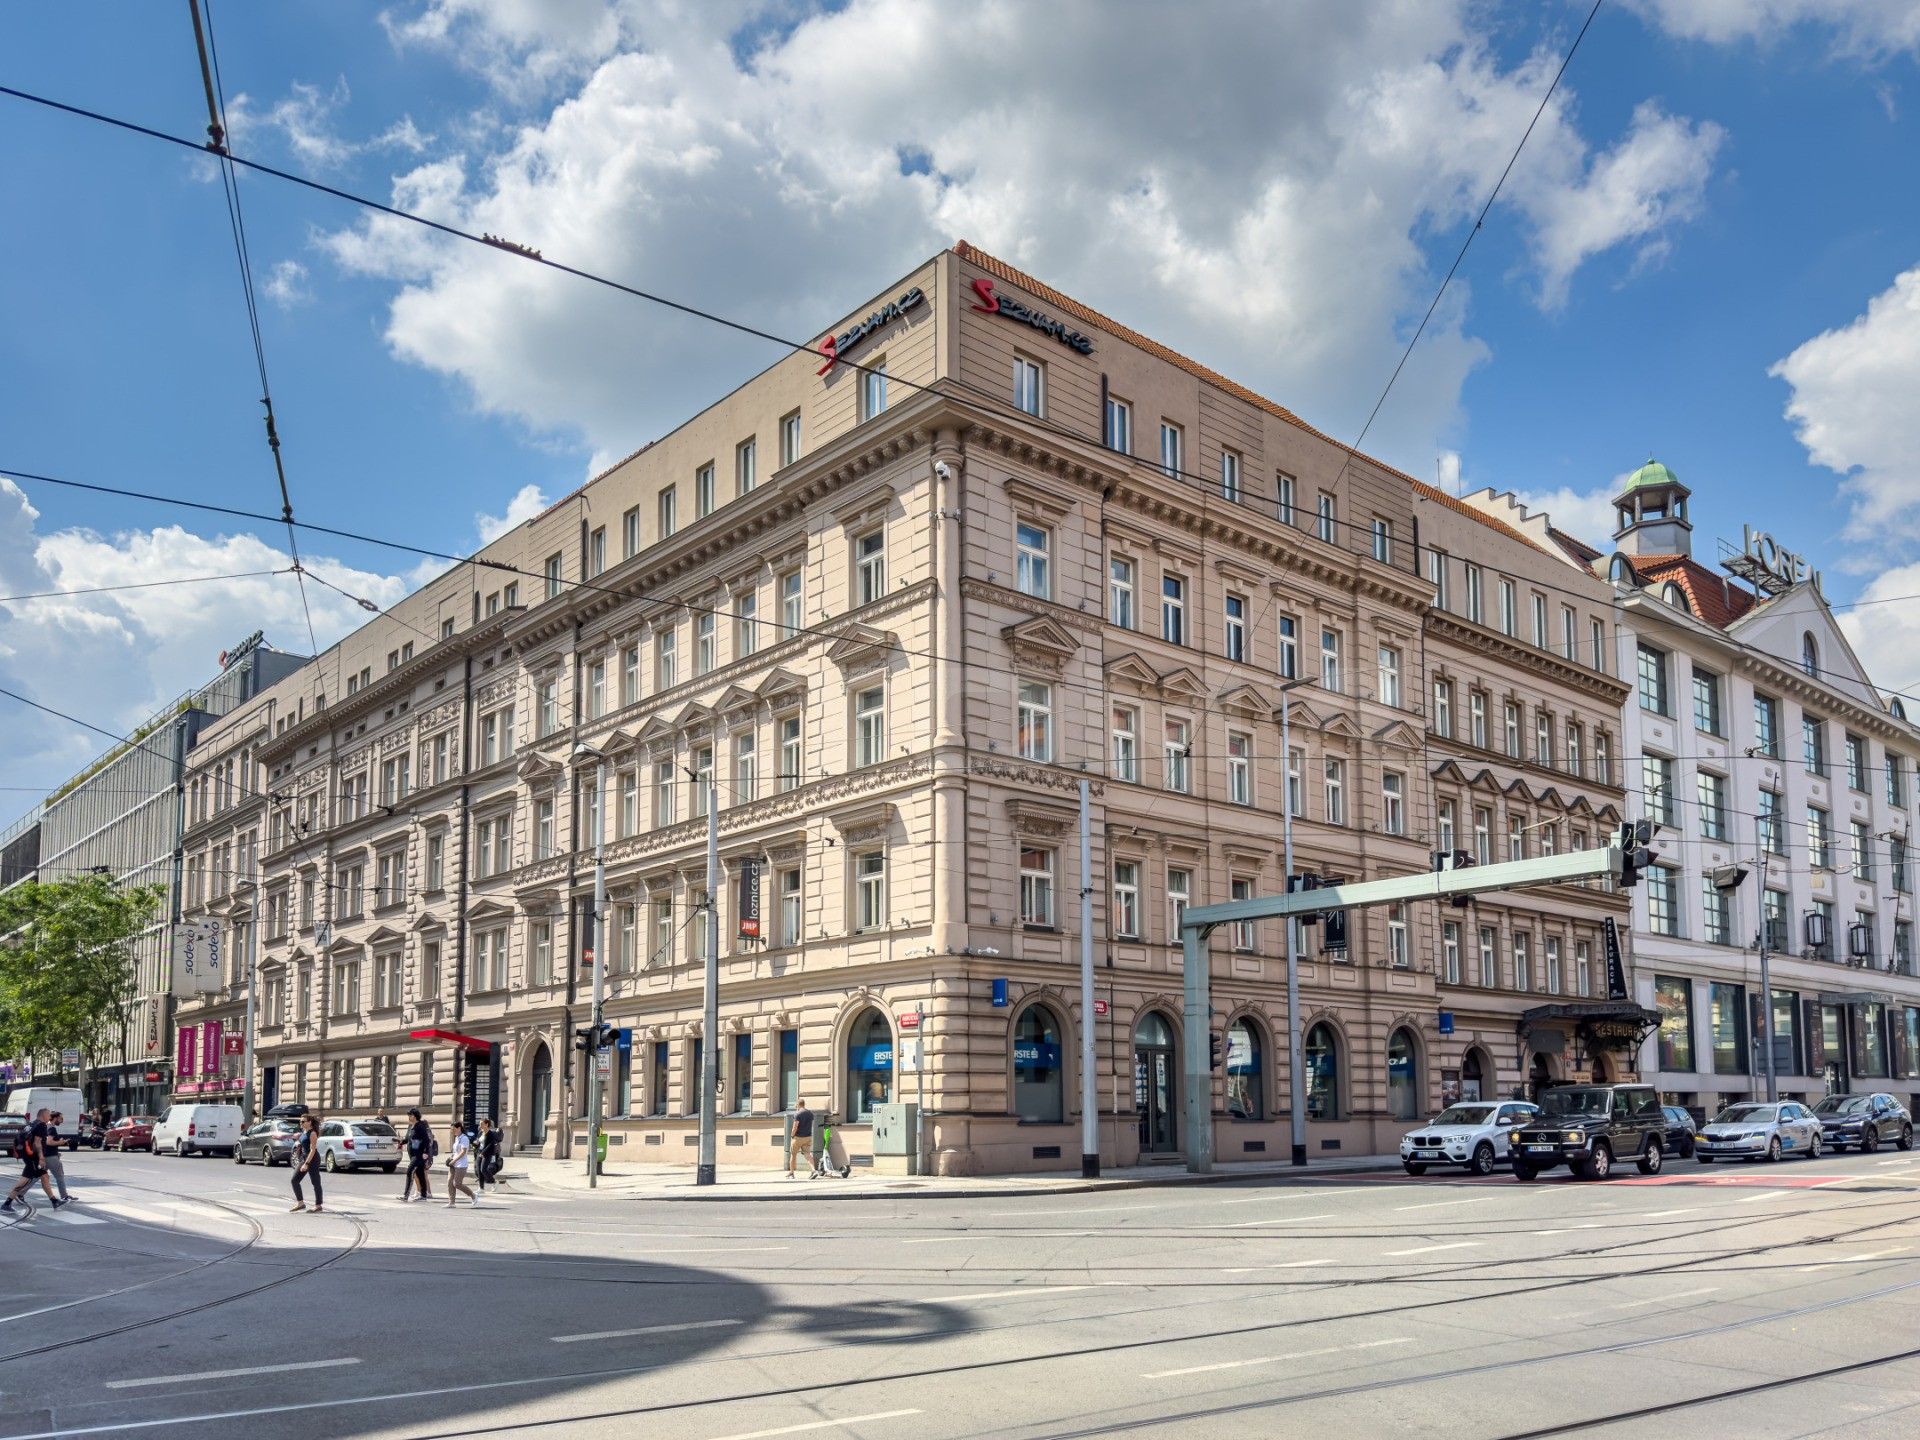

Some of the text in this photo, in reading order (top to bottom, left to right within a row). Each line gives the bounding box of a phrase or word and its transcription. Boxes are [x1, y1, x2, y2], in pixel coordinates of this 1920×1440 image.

[816, 286, 923, 376] SEZNAM.CZ
[970, 278, 1094, 355] SEZNAM.CZ
[208, 921, 220, 969] sodexo
[742, 921, 758, 930] JMP
[184, 929, 195, 975] sodexo
[1607, 919, 1615, 984] RESTAURACE
[146, 998, 159, 1051] SEZNAM.CZ
[1013, 1049, 1031, 1059] RSTE
